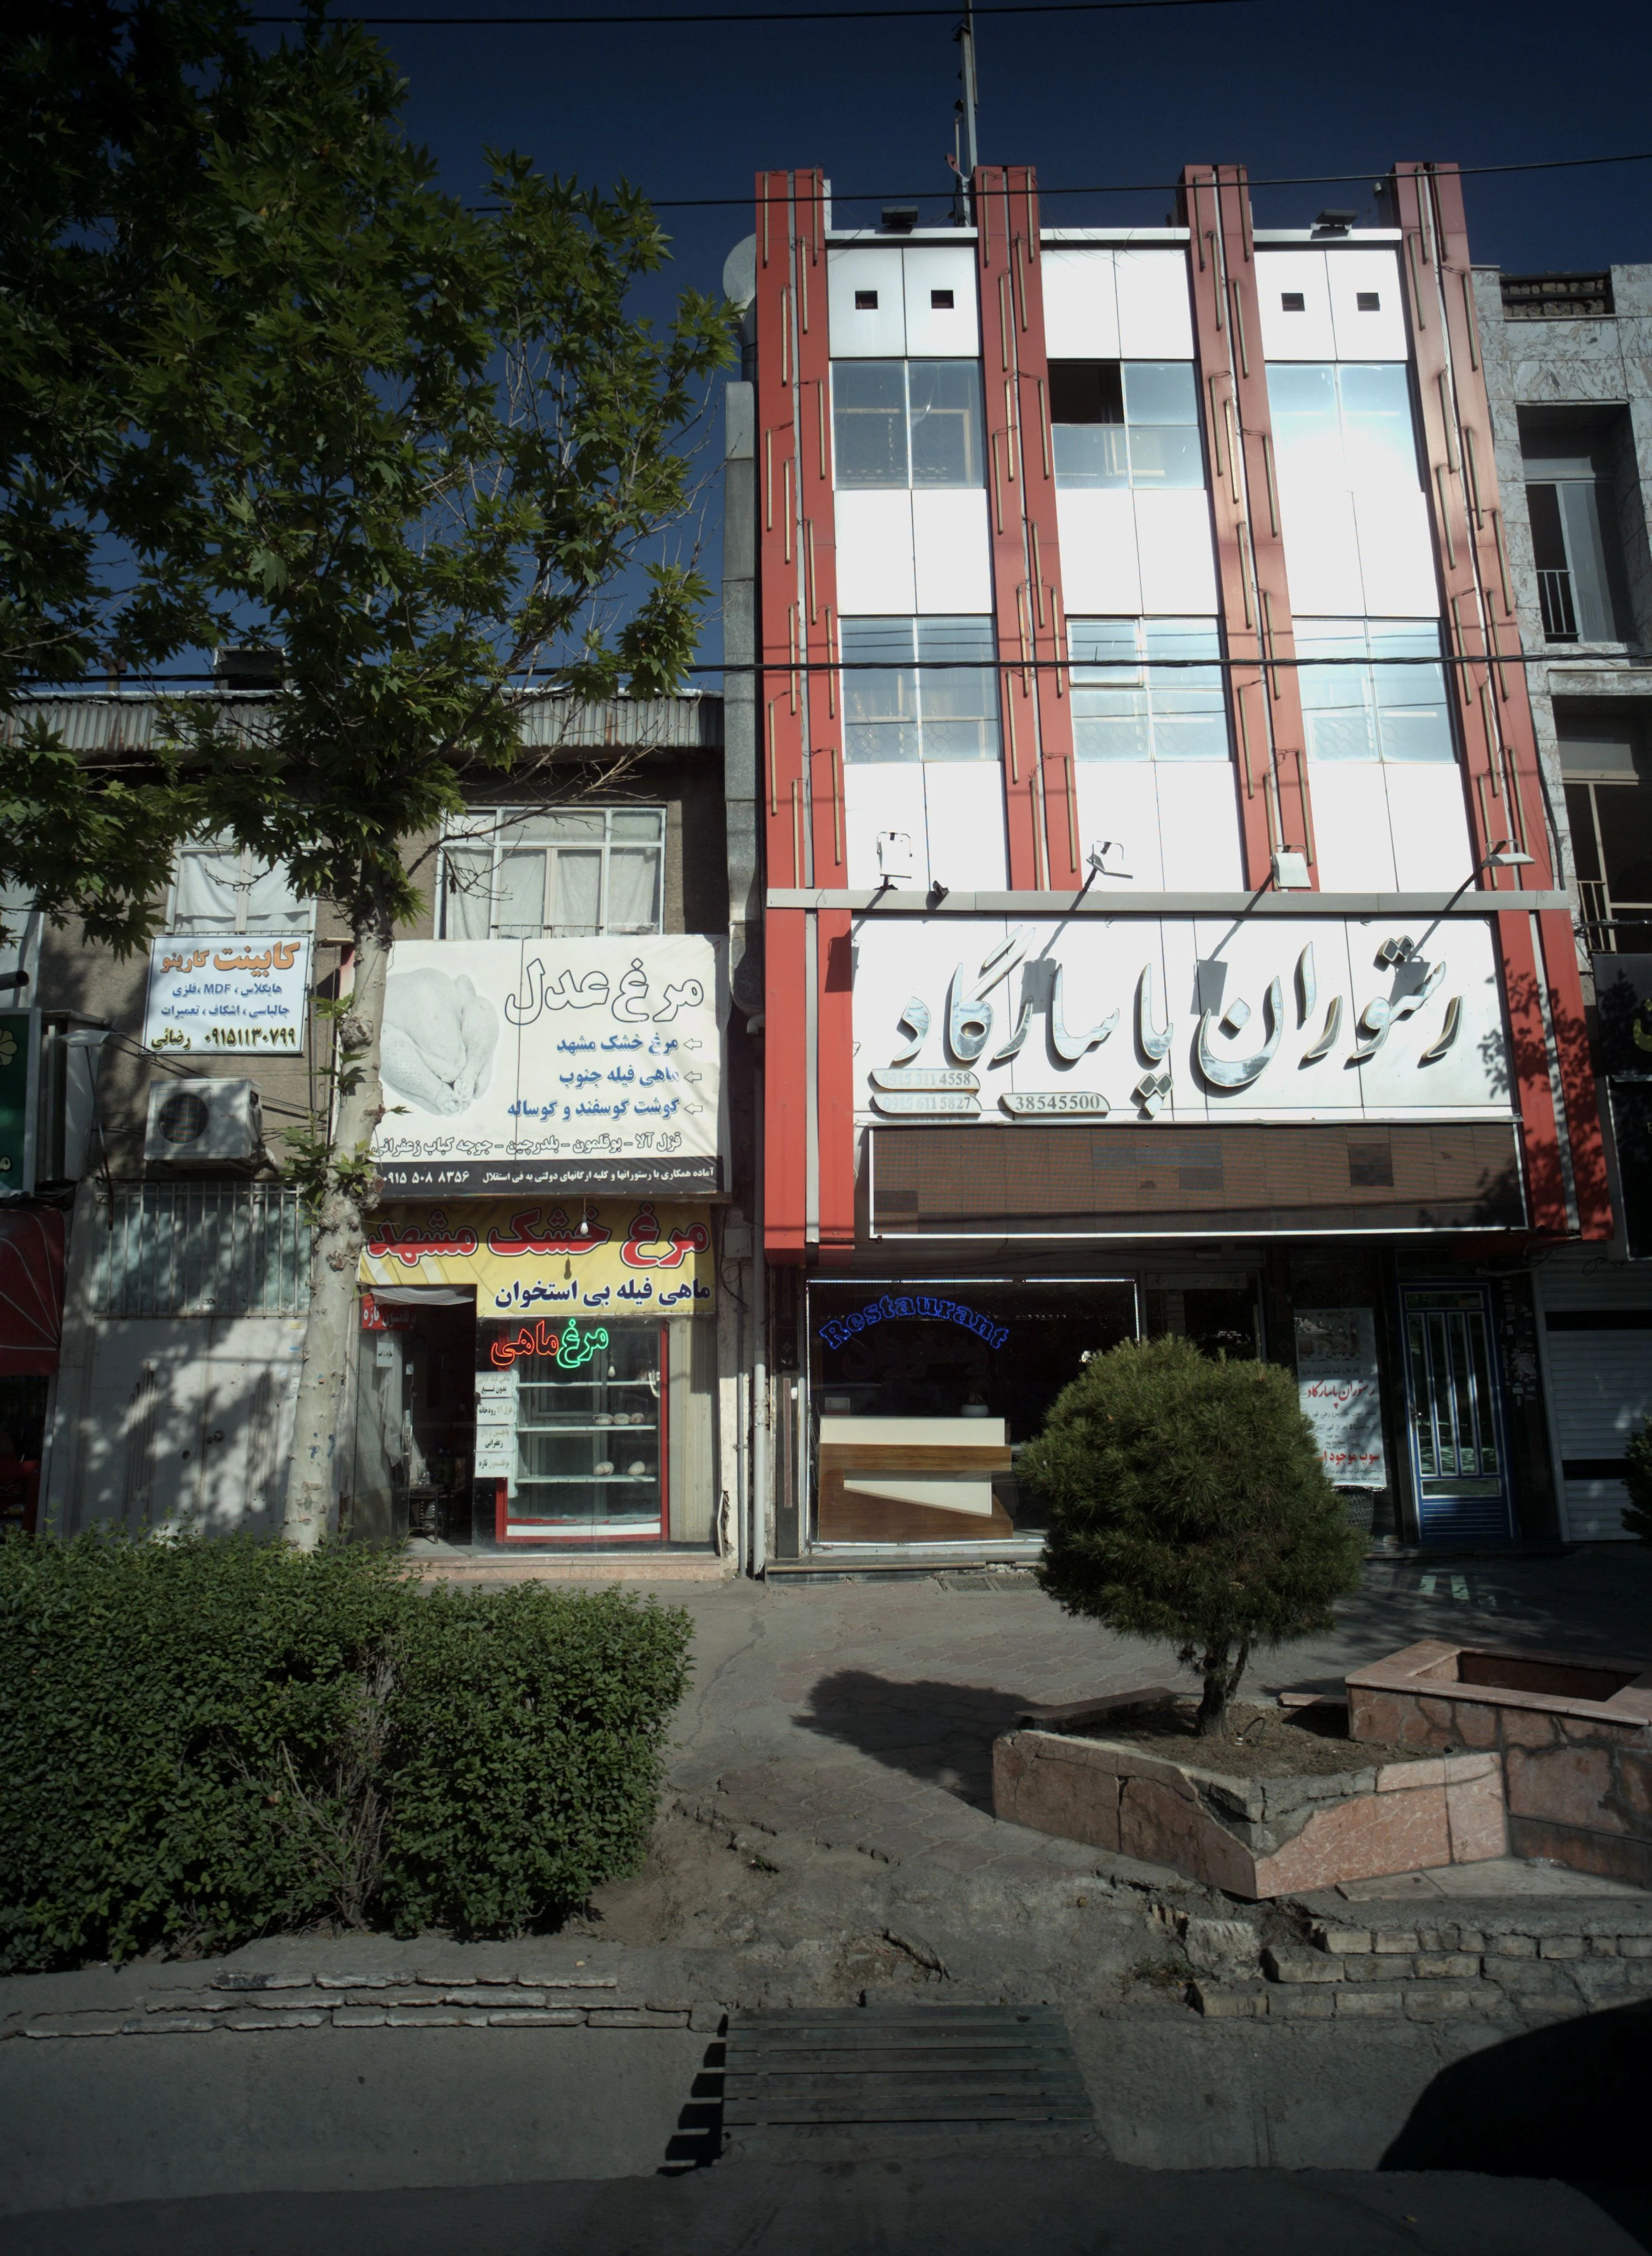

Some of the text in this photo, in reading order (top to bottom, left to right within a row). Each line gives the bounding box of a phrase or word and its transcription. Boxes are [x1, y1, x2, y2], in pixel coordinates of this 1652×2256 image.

[160, 941, 300, 977] کابینت کارینو
[204, 984, 231, 994] MDF
[505, 958, 704, 1025] مرغ عدل
[161, 1005, 199, 1018] تعمیرات
[209, 1004, 240, 1016] اشکاف
[249, 1004, 290, 1018] جالباسی
[892, 924, 1465, 1117] رستوران پاسارگاد
[557, 1032, 678, 1055] مرغ خشک مشهد
[559, 1064, 680, 1088] ماهی فیله جنوب
[915, 1072, 936, 1086] 311
[939, 1072, 971, 1086] 4558
[507, 1097, 680, 1121] گوشت گوسفند و گوساله
[940, 1097, 971, 1110] 5827
[1015, 1095, 1100, 1110] 38545500
[371, 1137, 421, 1157] زعفرانی
[423, 1137, 454, 1156] کباب
[457, 1139, 493, 1155] جوجه
[506, 1135, 559, 1155] بلدرچین
[573, 1134, 622, 1153] بوقلمون
[635, 1132, 654, 1148] آلا
[656, 1132, 682, 1152] قزل
[412, 1172, 433, 1184] ۵۰۸
[438, 1171, 470, 1183] ۸۳۵۶
[534, 1172, 558, 1183] دولتی
[594, 1170, 608, 1181] کلیه
[653, 1169, 659, 1180] با
[660, 1169, 691, 1180] همکاری
[693, 1167, 715, 1177] آماده
[367, 1202, 710, 1270] مرغ خشک مشهد
[495, 1276, 711, 1309] ماهی فیله بی استخوان
[819, 1293, 1010, 1351] Restaurant
[491, 1317, 610, 1369] مرغ ماهی
[1338, 1379, 1375, 1401] رستوران
[485, 1439, 503, 1449] زعفرانی
[1329, 1452, 1357, 1466] موجود
